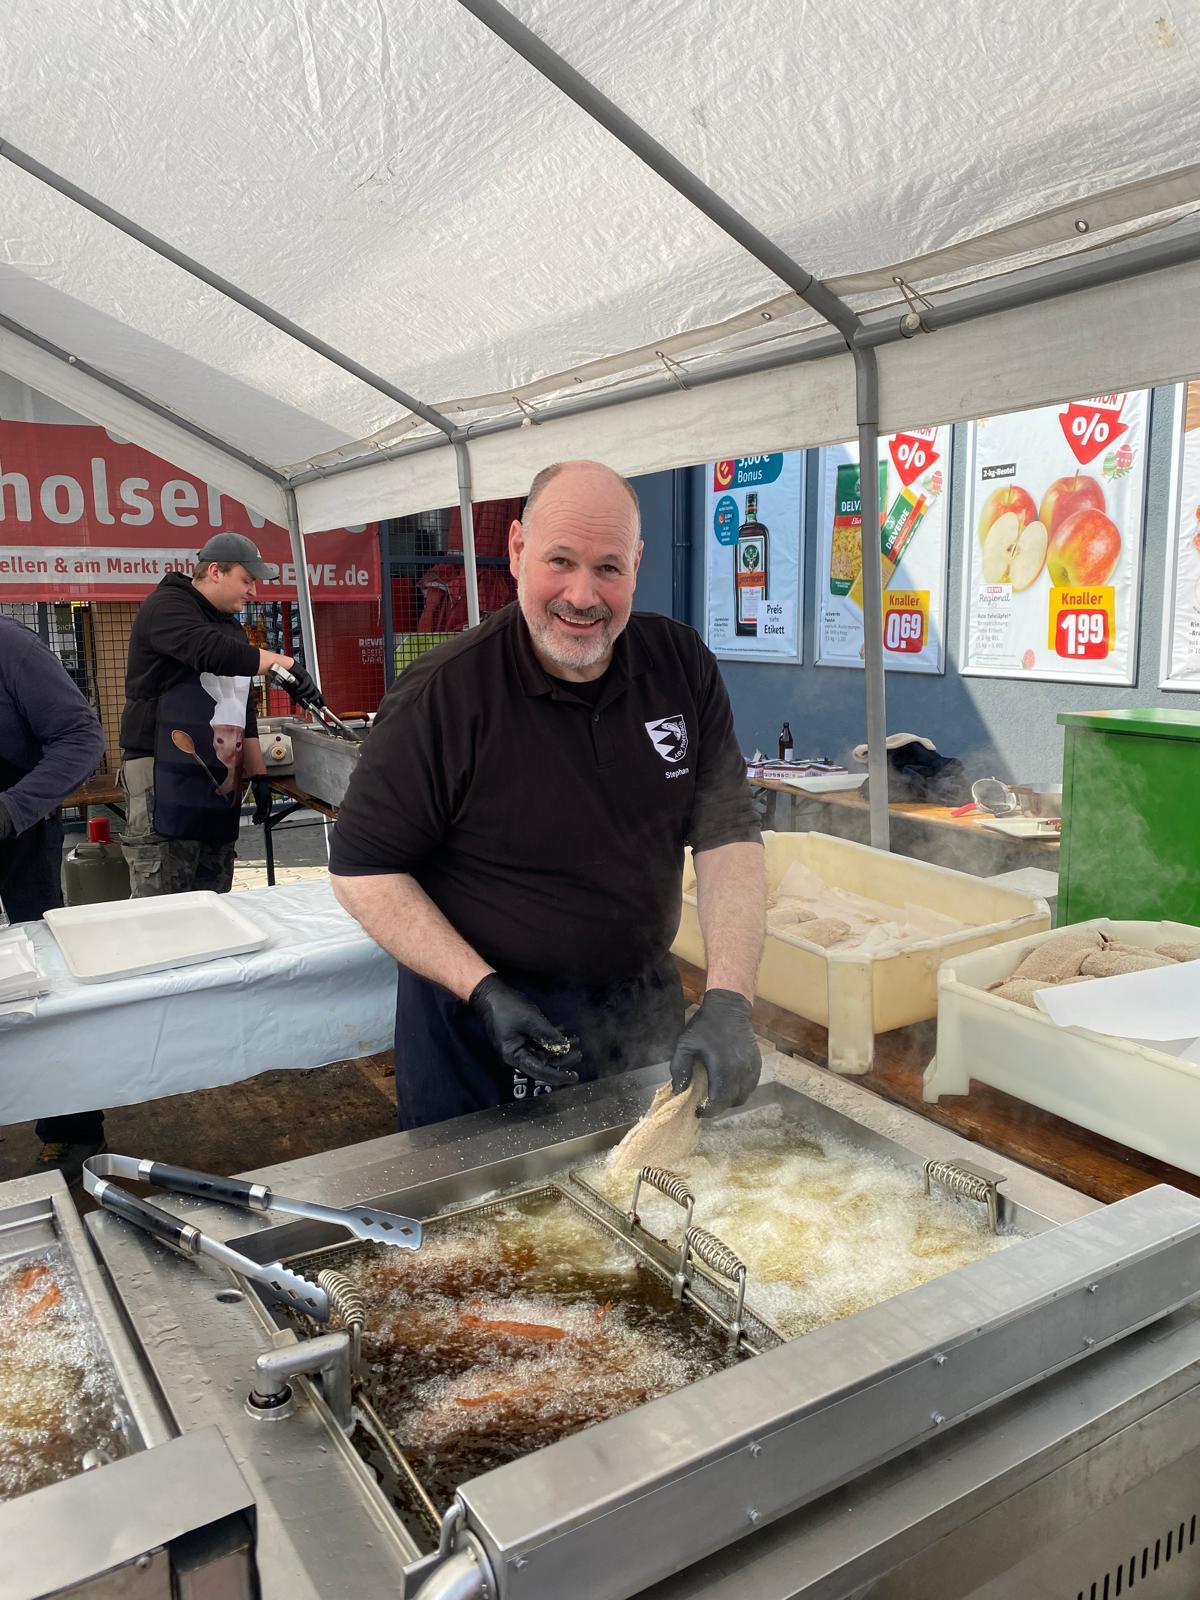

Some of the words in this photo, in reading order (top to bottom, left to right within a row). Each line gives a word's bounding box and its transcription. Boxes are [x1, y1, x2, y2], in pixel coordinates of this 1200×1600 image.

[1072, 412, 1109, 446] %
[898, 441, 926, 469] %
[737, 469, 763, 483] Bonus
[885, 507, 910, 550] DELVERDE
[54, 557, 68, 573] &
[74, 560, 100, 573] am
[107, 557, 158, 574] Markt
[889, 594, 920, 606] Knaller
[1061, 592, 1103, 605] Knaller
[766, 604, 782, 614] Preis
[764, 624, 785, 634] Etikett
[886, 613, 922, 648] 0.69
[1061, 613, 1104, 655] 1.99
[665, 767, 689, 778] Stephan
